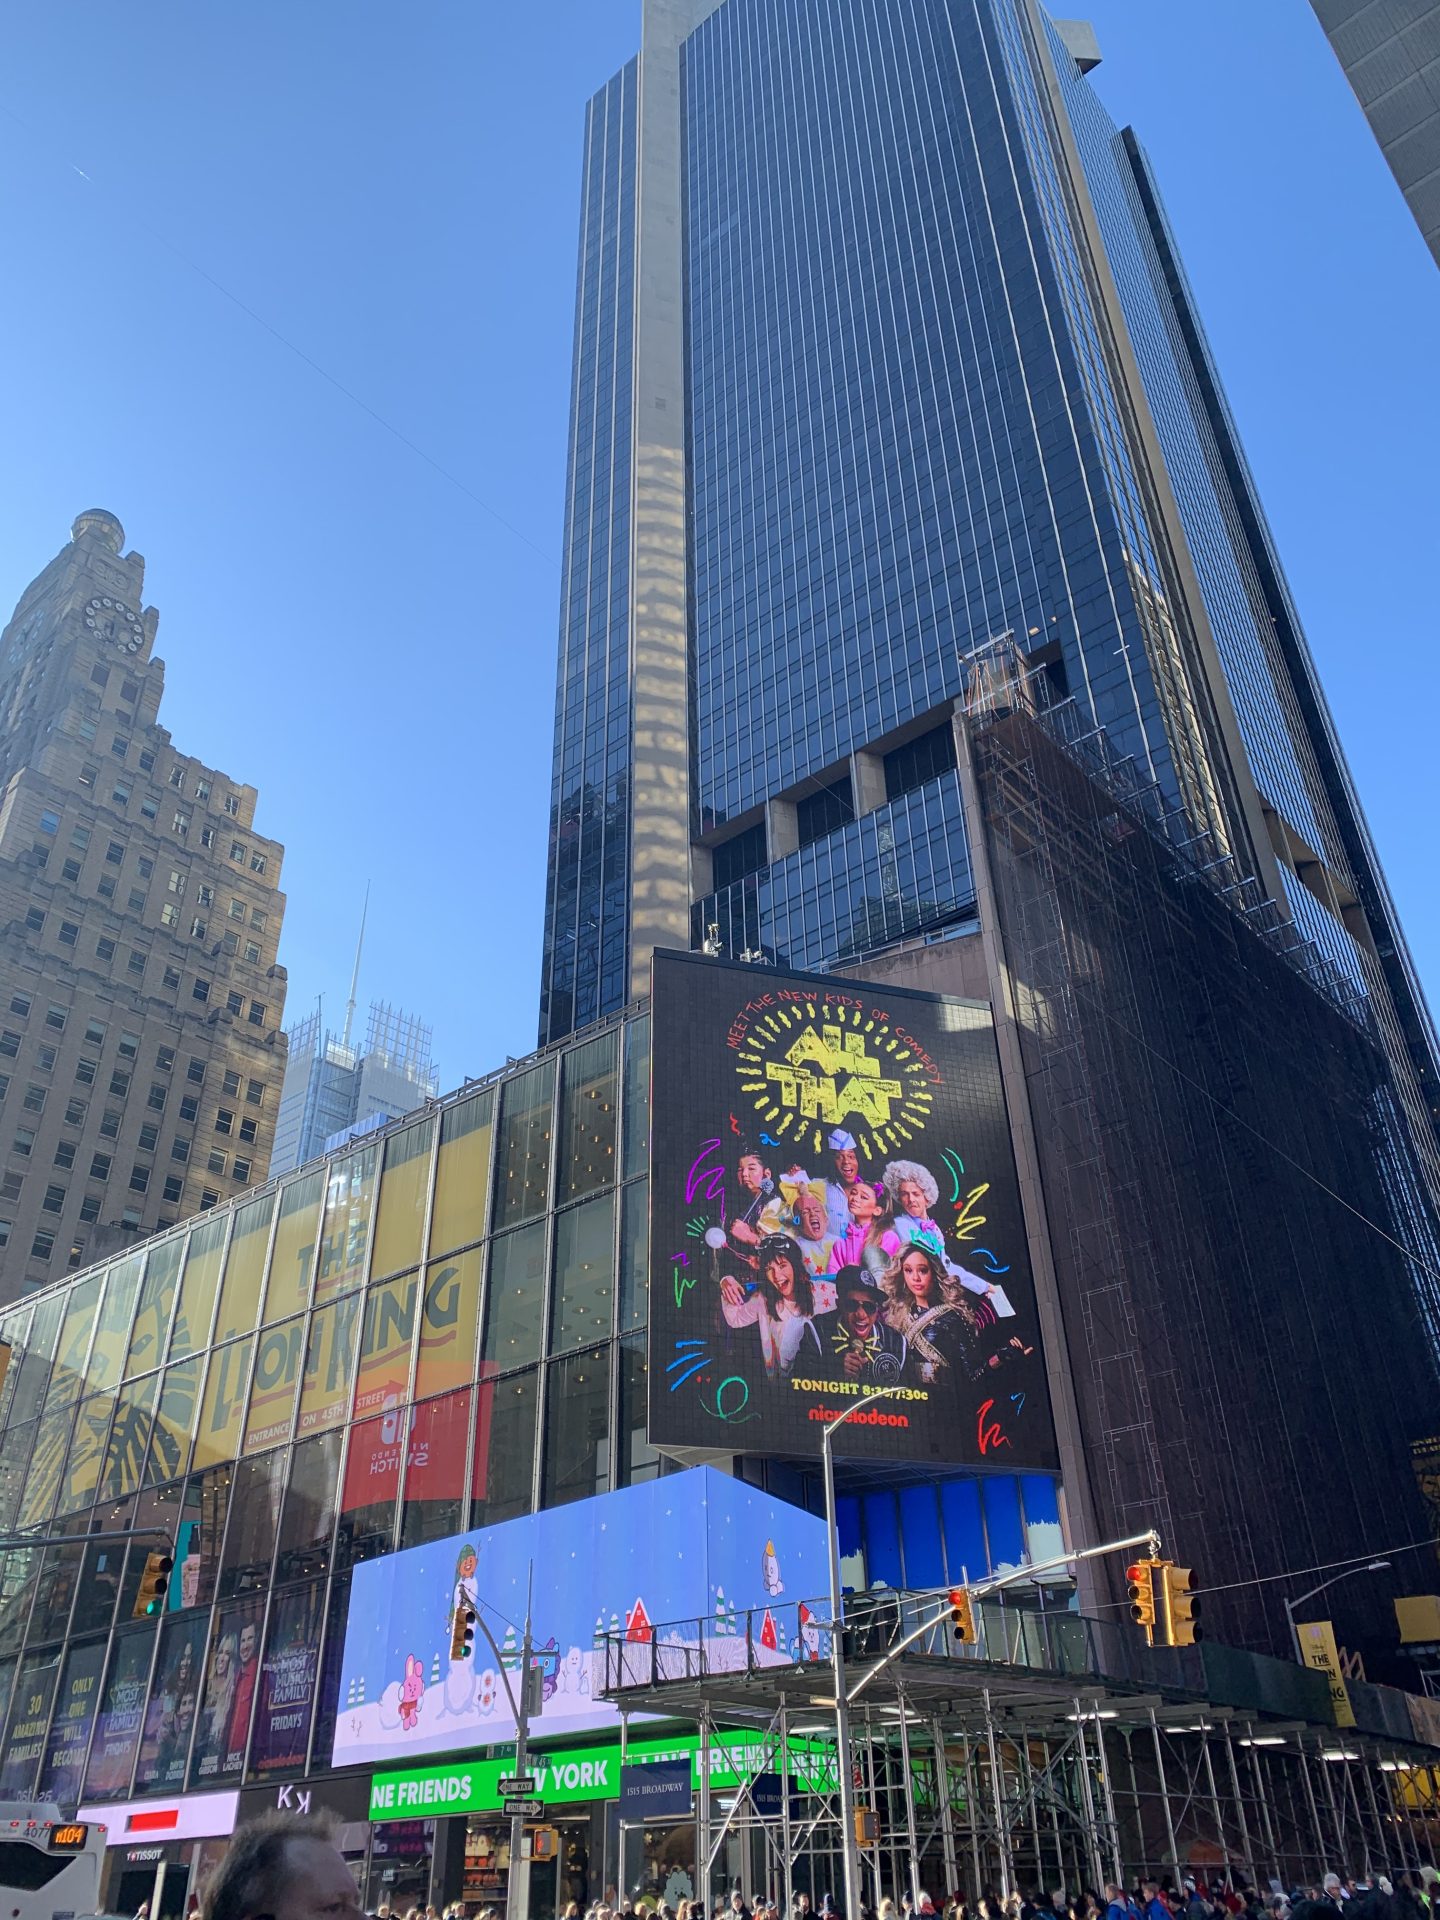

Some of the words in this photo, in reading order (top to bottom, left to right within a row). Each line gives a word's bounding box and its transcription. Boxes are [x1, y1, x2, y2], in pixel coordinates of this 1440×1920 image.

[726, 1011, 751, 1050] MEET
[745, 993, 777, 1014] THE
[777, 989, 818, 1001] NEW
[825, 993, 863, 1010] KIDS
[871, 1009, 890, 1022] OF
[895, 1026, 945, 1084] COMEDY
[785, 1024, 881, 1078] ALL
[766, 1061, 902, 1129] THAT
[297, 1222, 369, 1288] THE
[211, 1317, 324, 1432] LION
[326, 1266, 460, 1393] KING
[791, 1378, 859, 1395] TONIGHT
[248, 1422, 290, 1444] ENTRANCE
[302, 1413, 316, 1427] ON
[321, 1405, 344, 1420] 45TH
[356, 1390, 386, 1410] STREET
[1312, 1654, 1330, 1665] THE
[71, 1676, 94, 1695] ONLY
[273, 1685, 307, 1704] FAMILY
[27, 1694, 42, 1716] 30
[68, 1701, 87, 1718] ONE
[270, 1713, 303, 1733] FRIDAYS
[63, 1725, 82, 1742] WILL
[8, 1742, 42, 1763] FAMILIES
[551, 1759, 609, 1791] YORK
[398, 1775, 472, 1806] FRIENDS
[517, 1783, 530, 1791] WAY
[627, 1786, 640, 1797] 1515
[641, 1782, 684, 1796] BROADWAY
[509, 1804, 521, 1812] ONE
[525, 1804, 537, 1812] WAY
[23, 1827, 51, 1838] 4077
[136, 1849, 163, 1862] TISSOT
